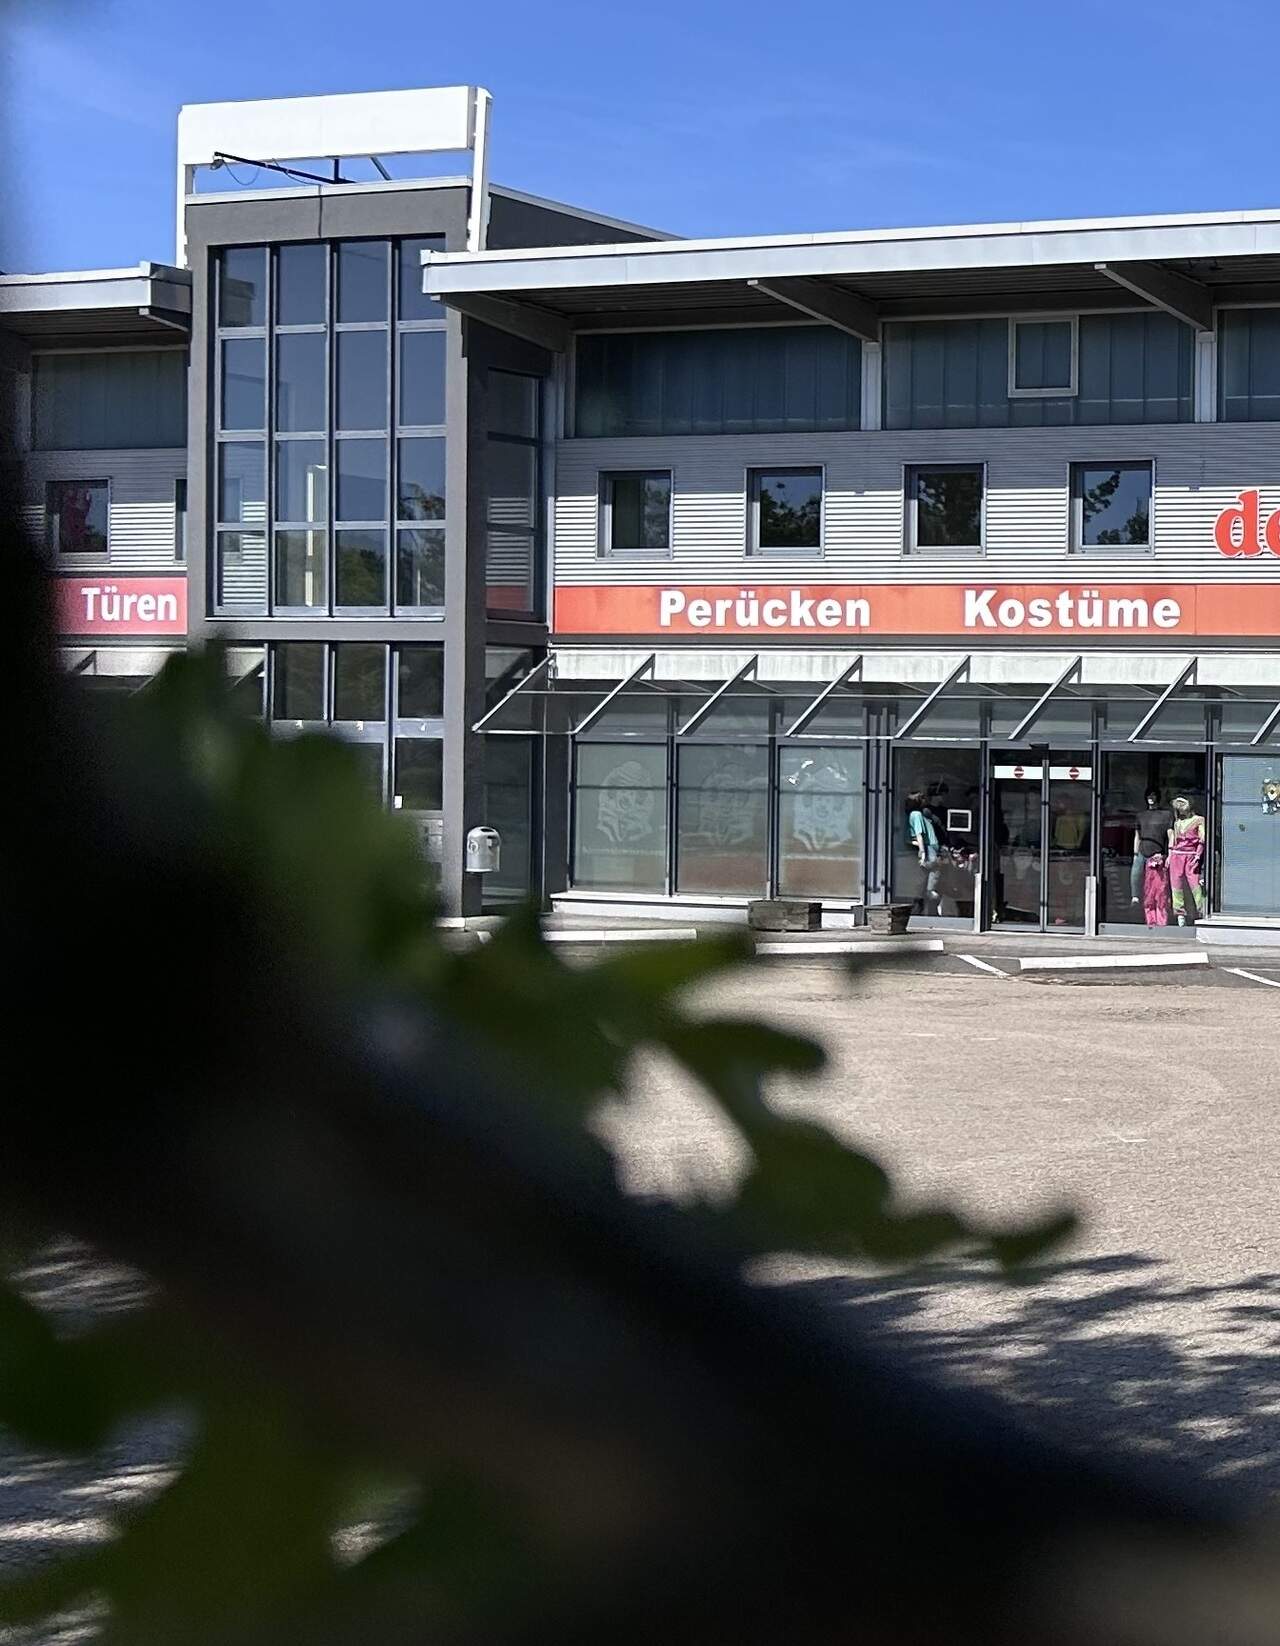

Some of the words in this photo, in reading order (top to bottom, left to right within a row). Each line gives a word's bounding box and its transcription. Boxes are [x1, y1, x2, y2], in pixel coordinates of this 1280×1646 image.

[81, 586, 178, 621] Türen
[659, 589, 871, 628] Perücken
[963, 589, 1181, 629] Kostüme
